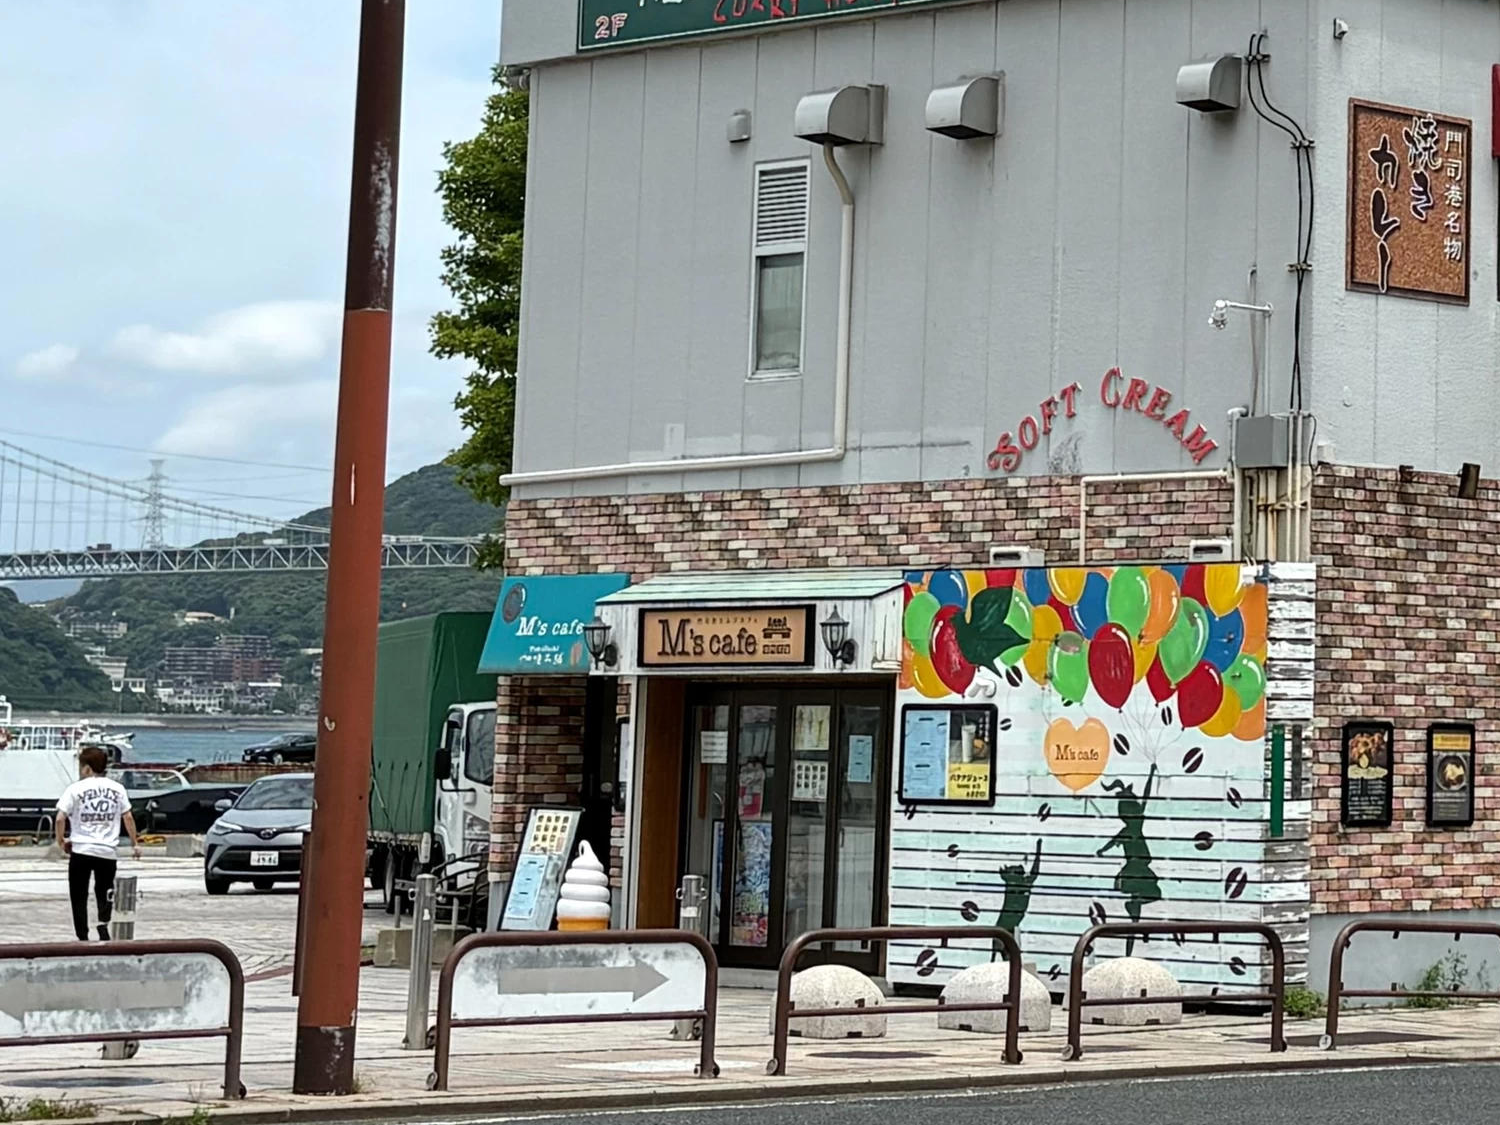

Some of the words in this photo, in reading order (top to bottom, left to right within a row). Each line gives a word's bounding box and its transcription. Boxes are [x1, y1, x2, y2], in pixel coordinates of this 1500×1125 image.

[594, 13, 627, 39] 2F
[1444, 130, 1463, 261] 門司港名物
[986, 381, 1082, 473] SOFT
[1100, 366, 1219, 465] CREAM
[515, 616, 548, 636] M's
[552, 619, 585, 636] cafe
[657, 618, 705, 656] M's
[709, 627, 758, 656] cafe
[1078, 748, 1099, 761] cafe
